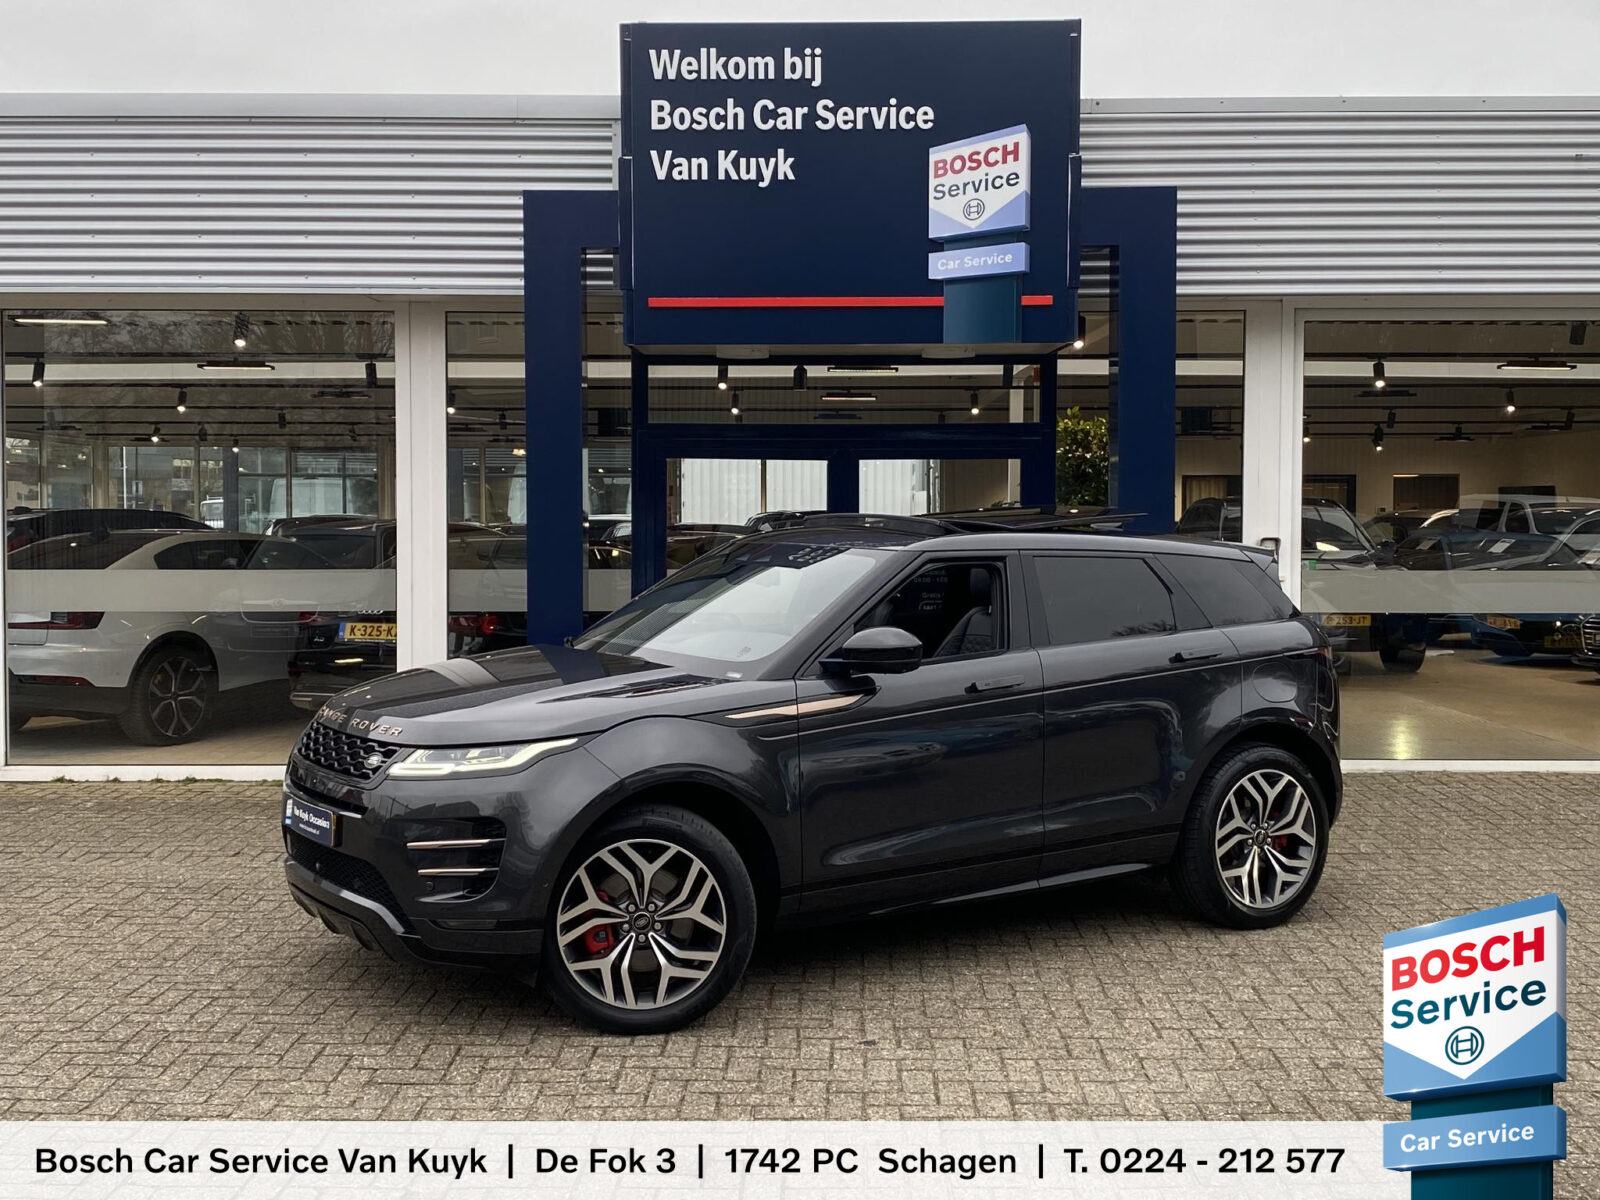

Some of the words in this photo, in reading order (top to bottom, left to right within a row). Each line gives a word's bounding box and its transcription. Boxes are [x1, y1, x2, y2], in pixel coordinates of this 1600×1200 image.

[649, 48, 775, 81] Welkom
[783, 48, 822, 87] bij
[650, 98, 745, 131] Bosch
[753, 98, 808, 131] Car
[815, 98, 935, 131] Service
[650, 149, 709, 181] Van
[717, 148, 796, 188] Kuyk
[934, 141, 1020, 179] BOSCH
[933, 172, 1020, 201] Service
[937, 258, 960, 271] Car
[963, 253, 1013, 268] Service
[349, 624, 397, 638] K-325-K
[351, 718, 402, 737] ROVER
